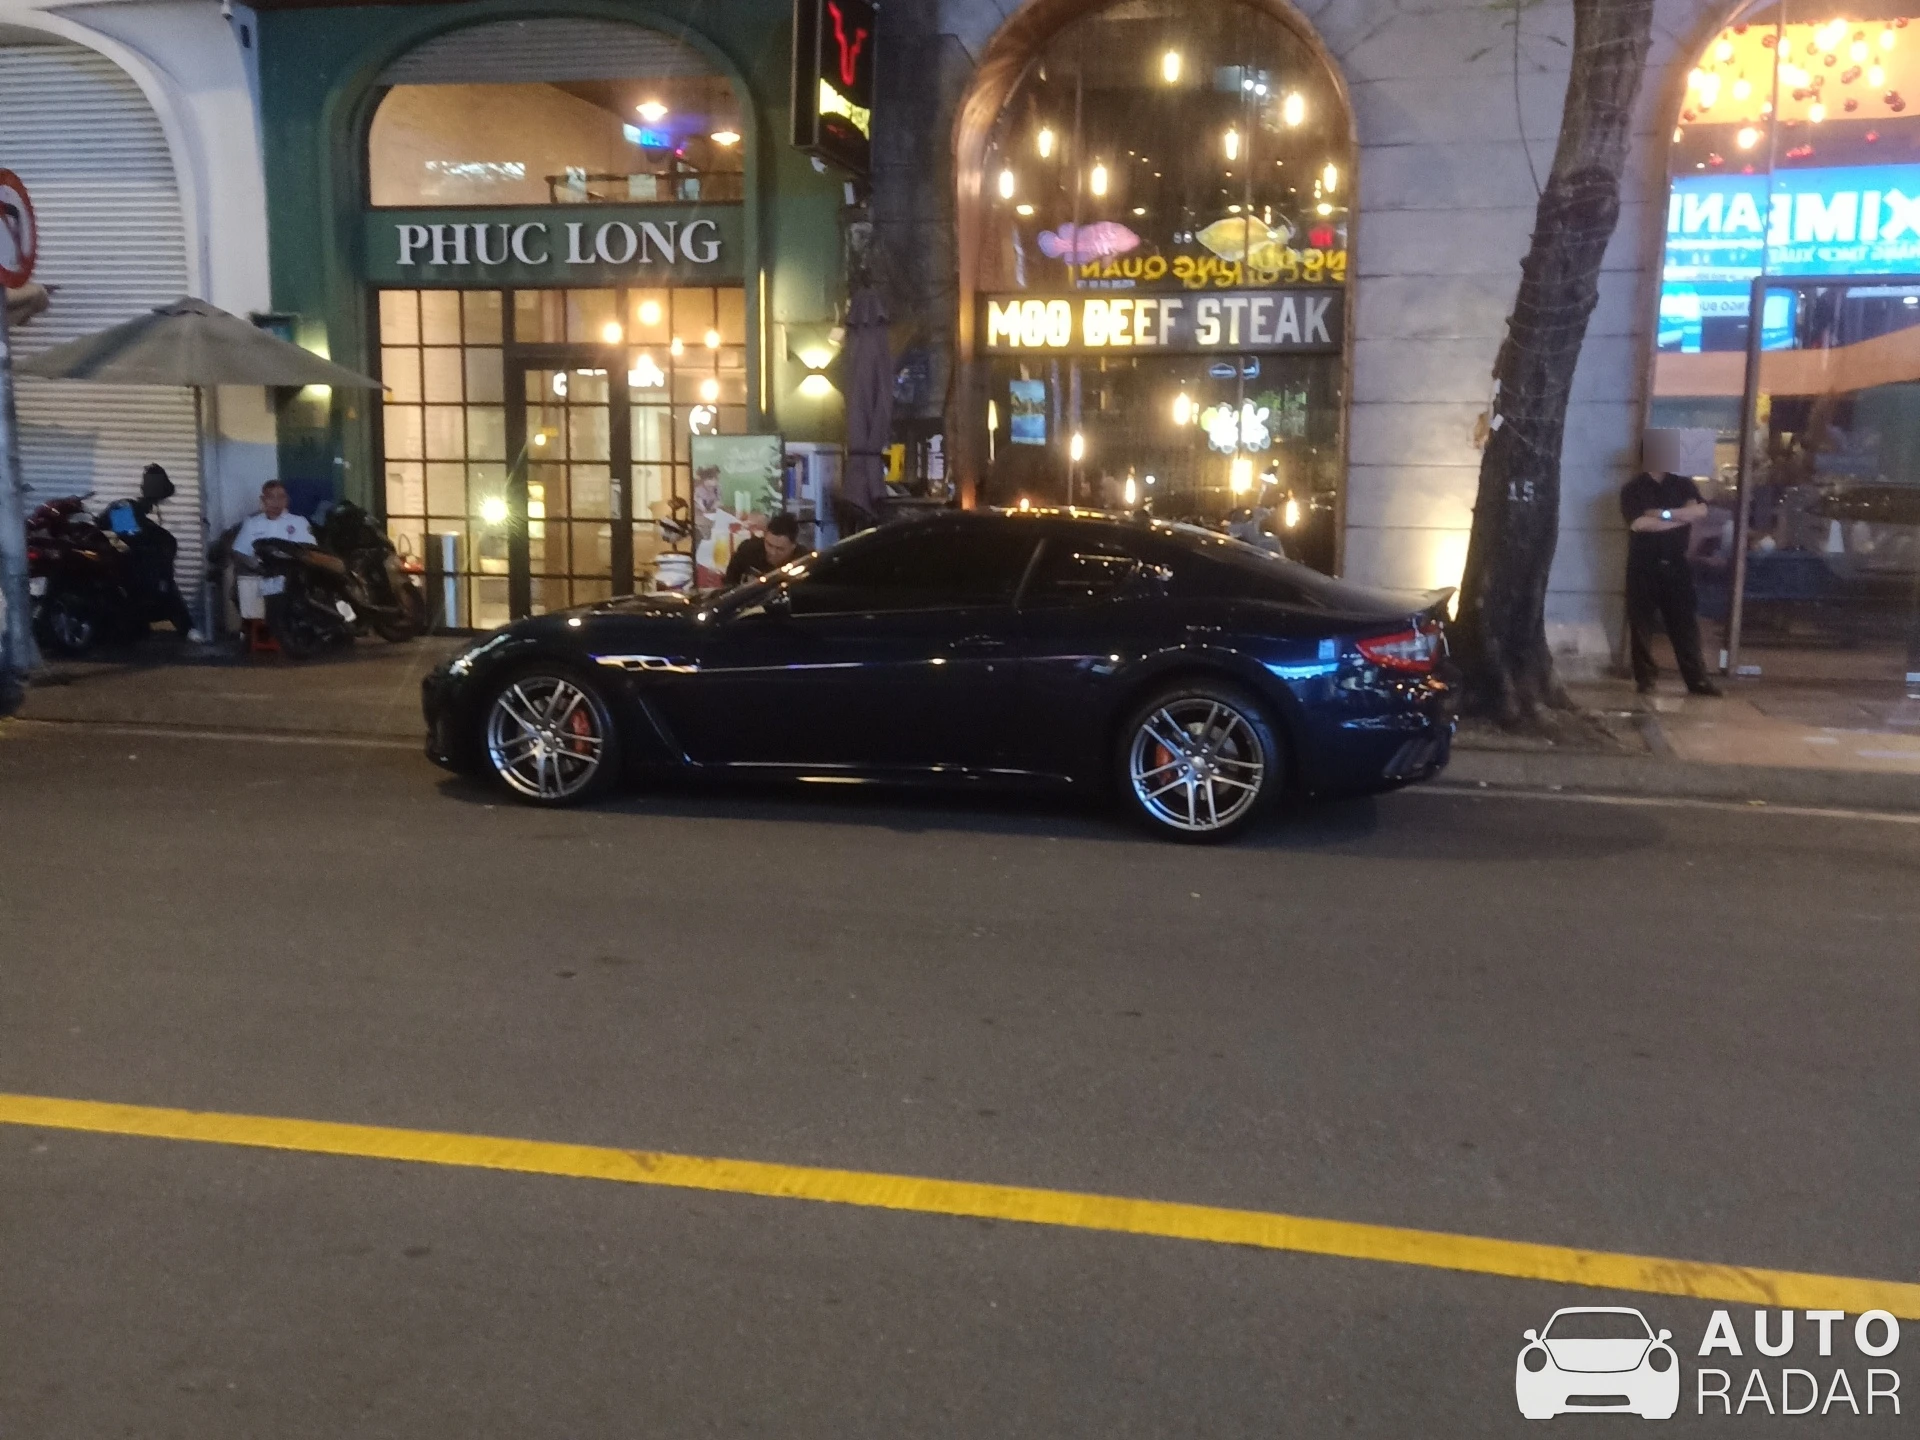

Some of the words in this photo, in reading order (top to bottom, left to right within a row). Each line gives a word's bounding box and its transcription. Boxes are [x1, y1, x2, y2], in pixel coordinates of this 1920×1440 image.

[395, 223, 549, 265] PHUC
[565, 219, 722, 265] LONG
[987, 300, 1072, 347] MOO
[1082, 298, 1184, 346] BEEF
[1195, 296, 1332, 345] STEAK
